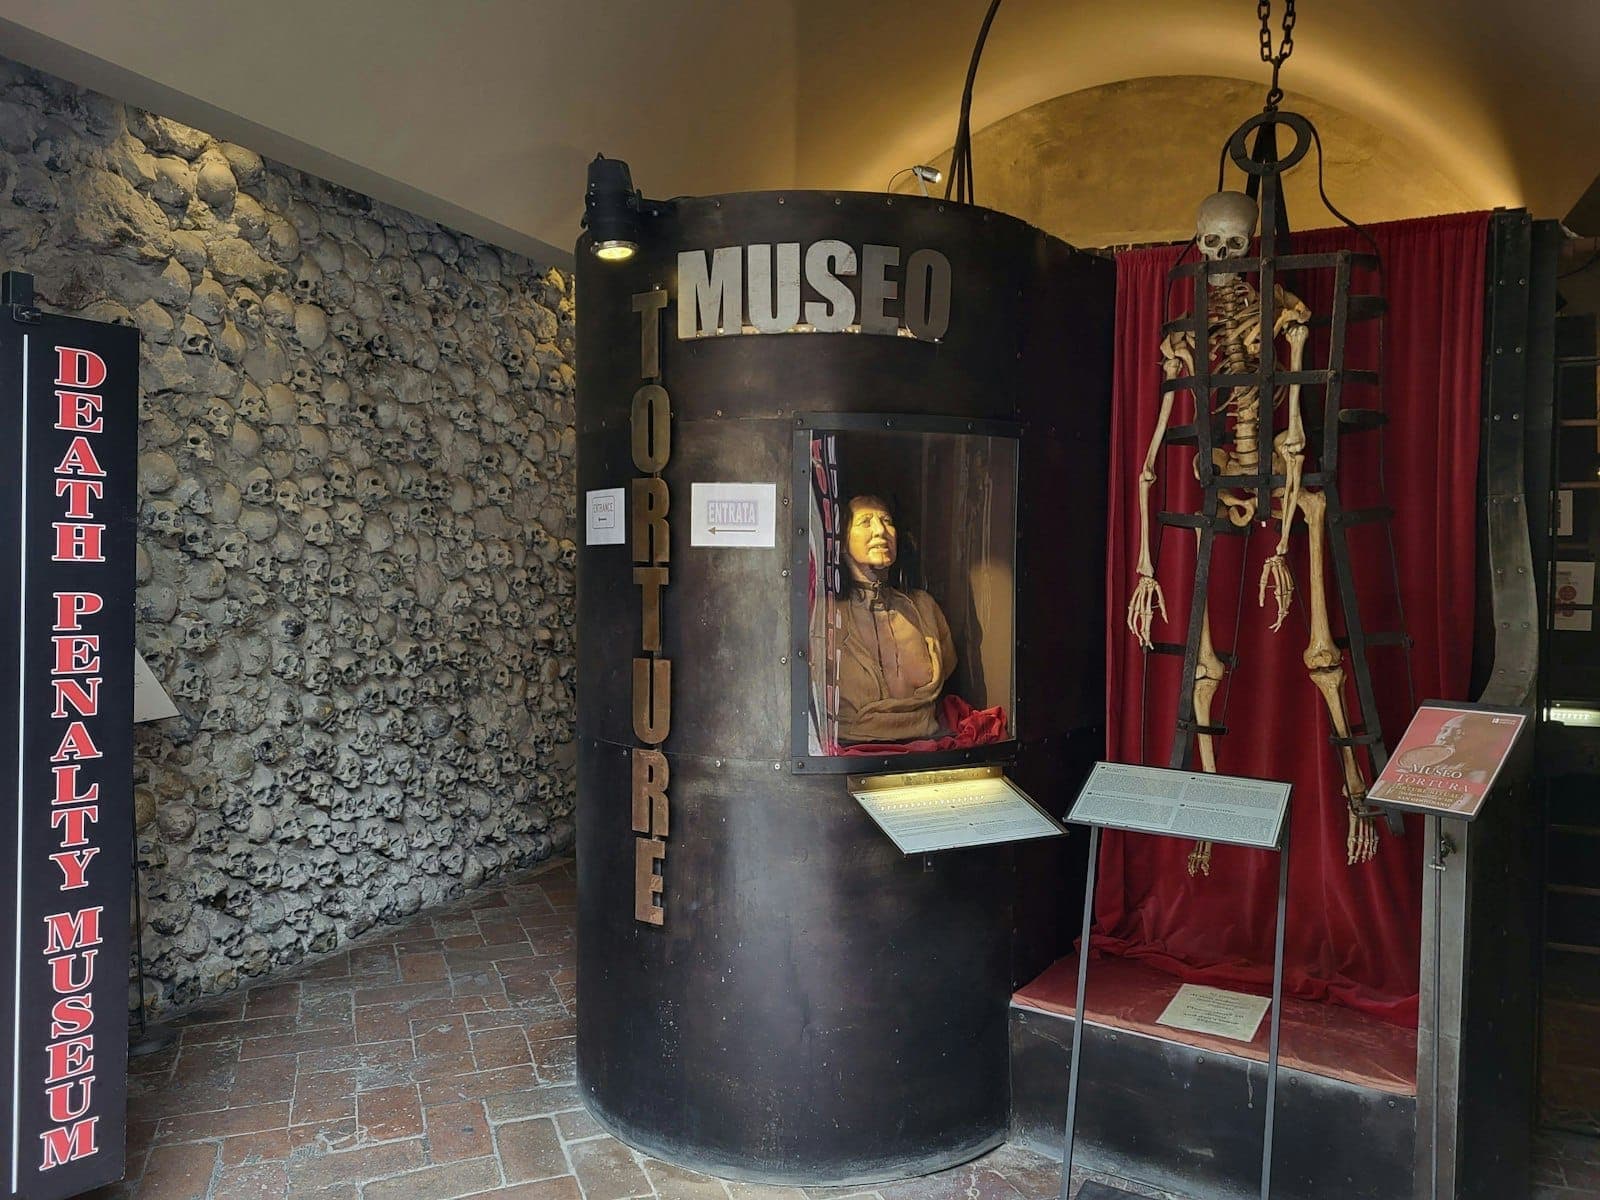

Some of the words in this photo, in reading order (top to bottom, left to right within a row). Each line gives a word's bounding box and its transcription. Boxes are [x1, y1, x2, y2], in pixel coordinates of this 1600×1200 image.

[677, 239, 951, 341] MUSEO
[52, 345, 106, 562] DEATH
[707, 501, 758, 525] ENTRATA
[631, 289, 672, 925] TORTURE
[49, 592, 104, 891] PENALTY
[1397, 774, 1471, 793] TORTURA
[1410, 763, 1462, 779] MUSEO
[39, 906, 103, 1171] MUSEUM
